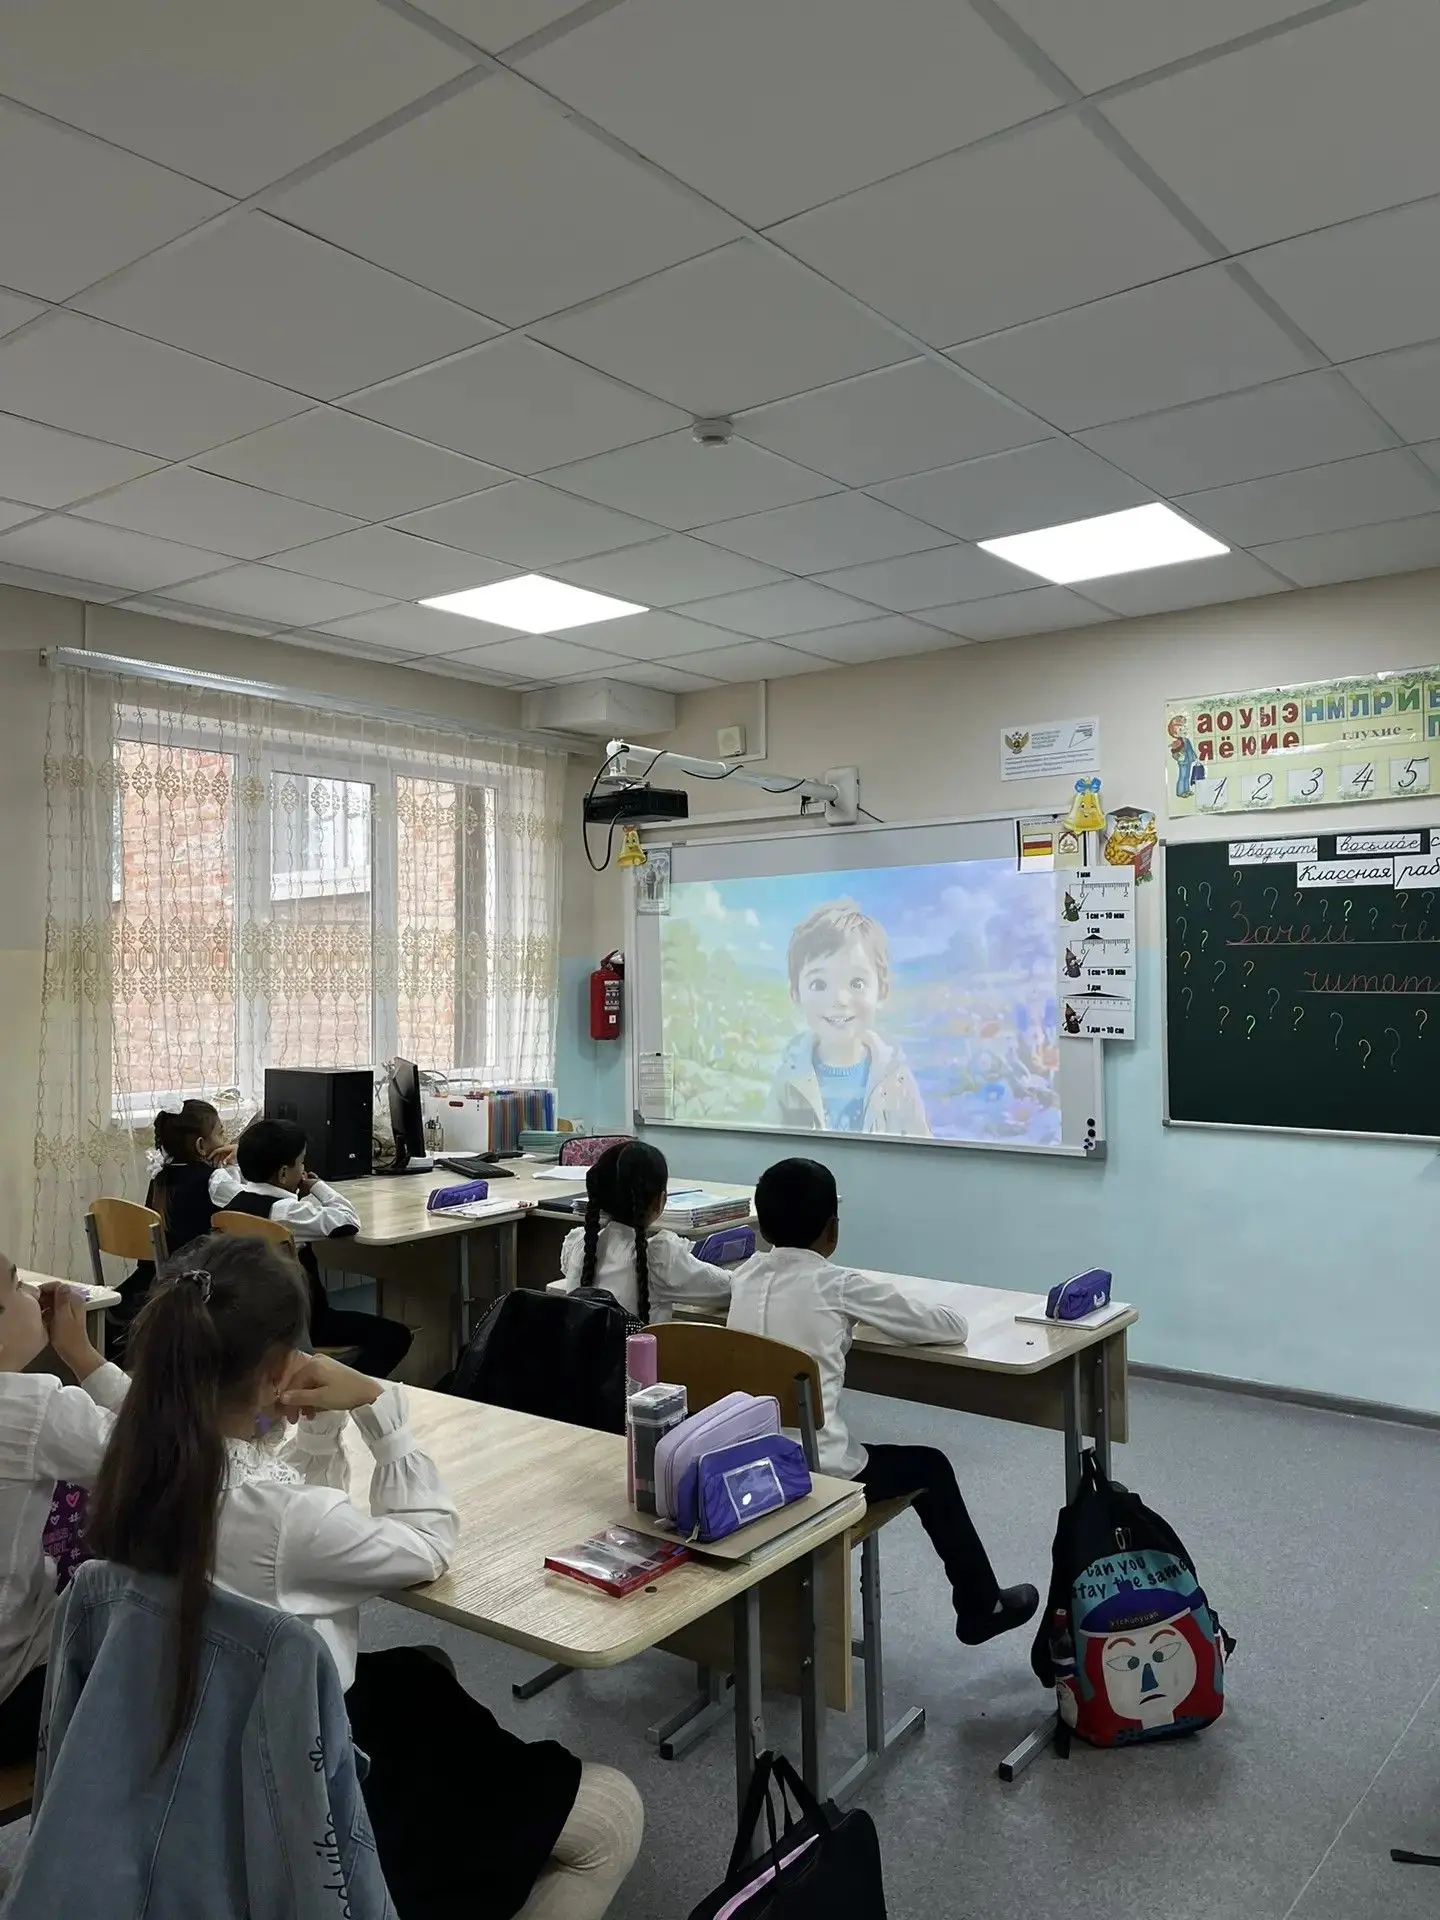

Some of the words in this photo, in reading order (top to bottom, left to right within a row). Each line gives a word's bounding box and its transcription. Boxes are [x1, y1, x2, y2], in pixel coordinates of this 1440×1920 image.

[1213, 776, 1228, 804] 1
[1251, 773, 1273, 800] 2
[1301, 767, 1324, 796] 3
[1352, 762, 1374, 792] 4
[1398, 757, 1429, 788] 5
[1299, 865, 1392, 885] Классная
[1230, 900, 1355, 944] Зачем
[1392, 919, 1435, 942] че
[1304, 970, 1440, 993] читат
[1117, 1556, 1146, 1575] you
